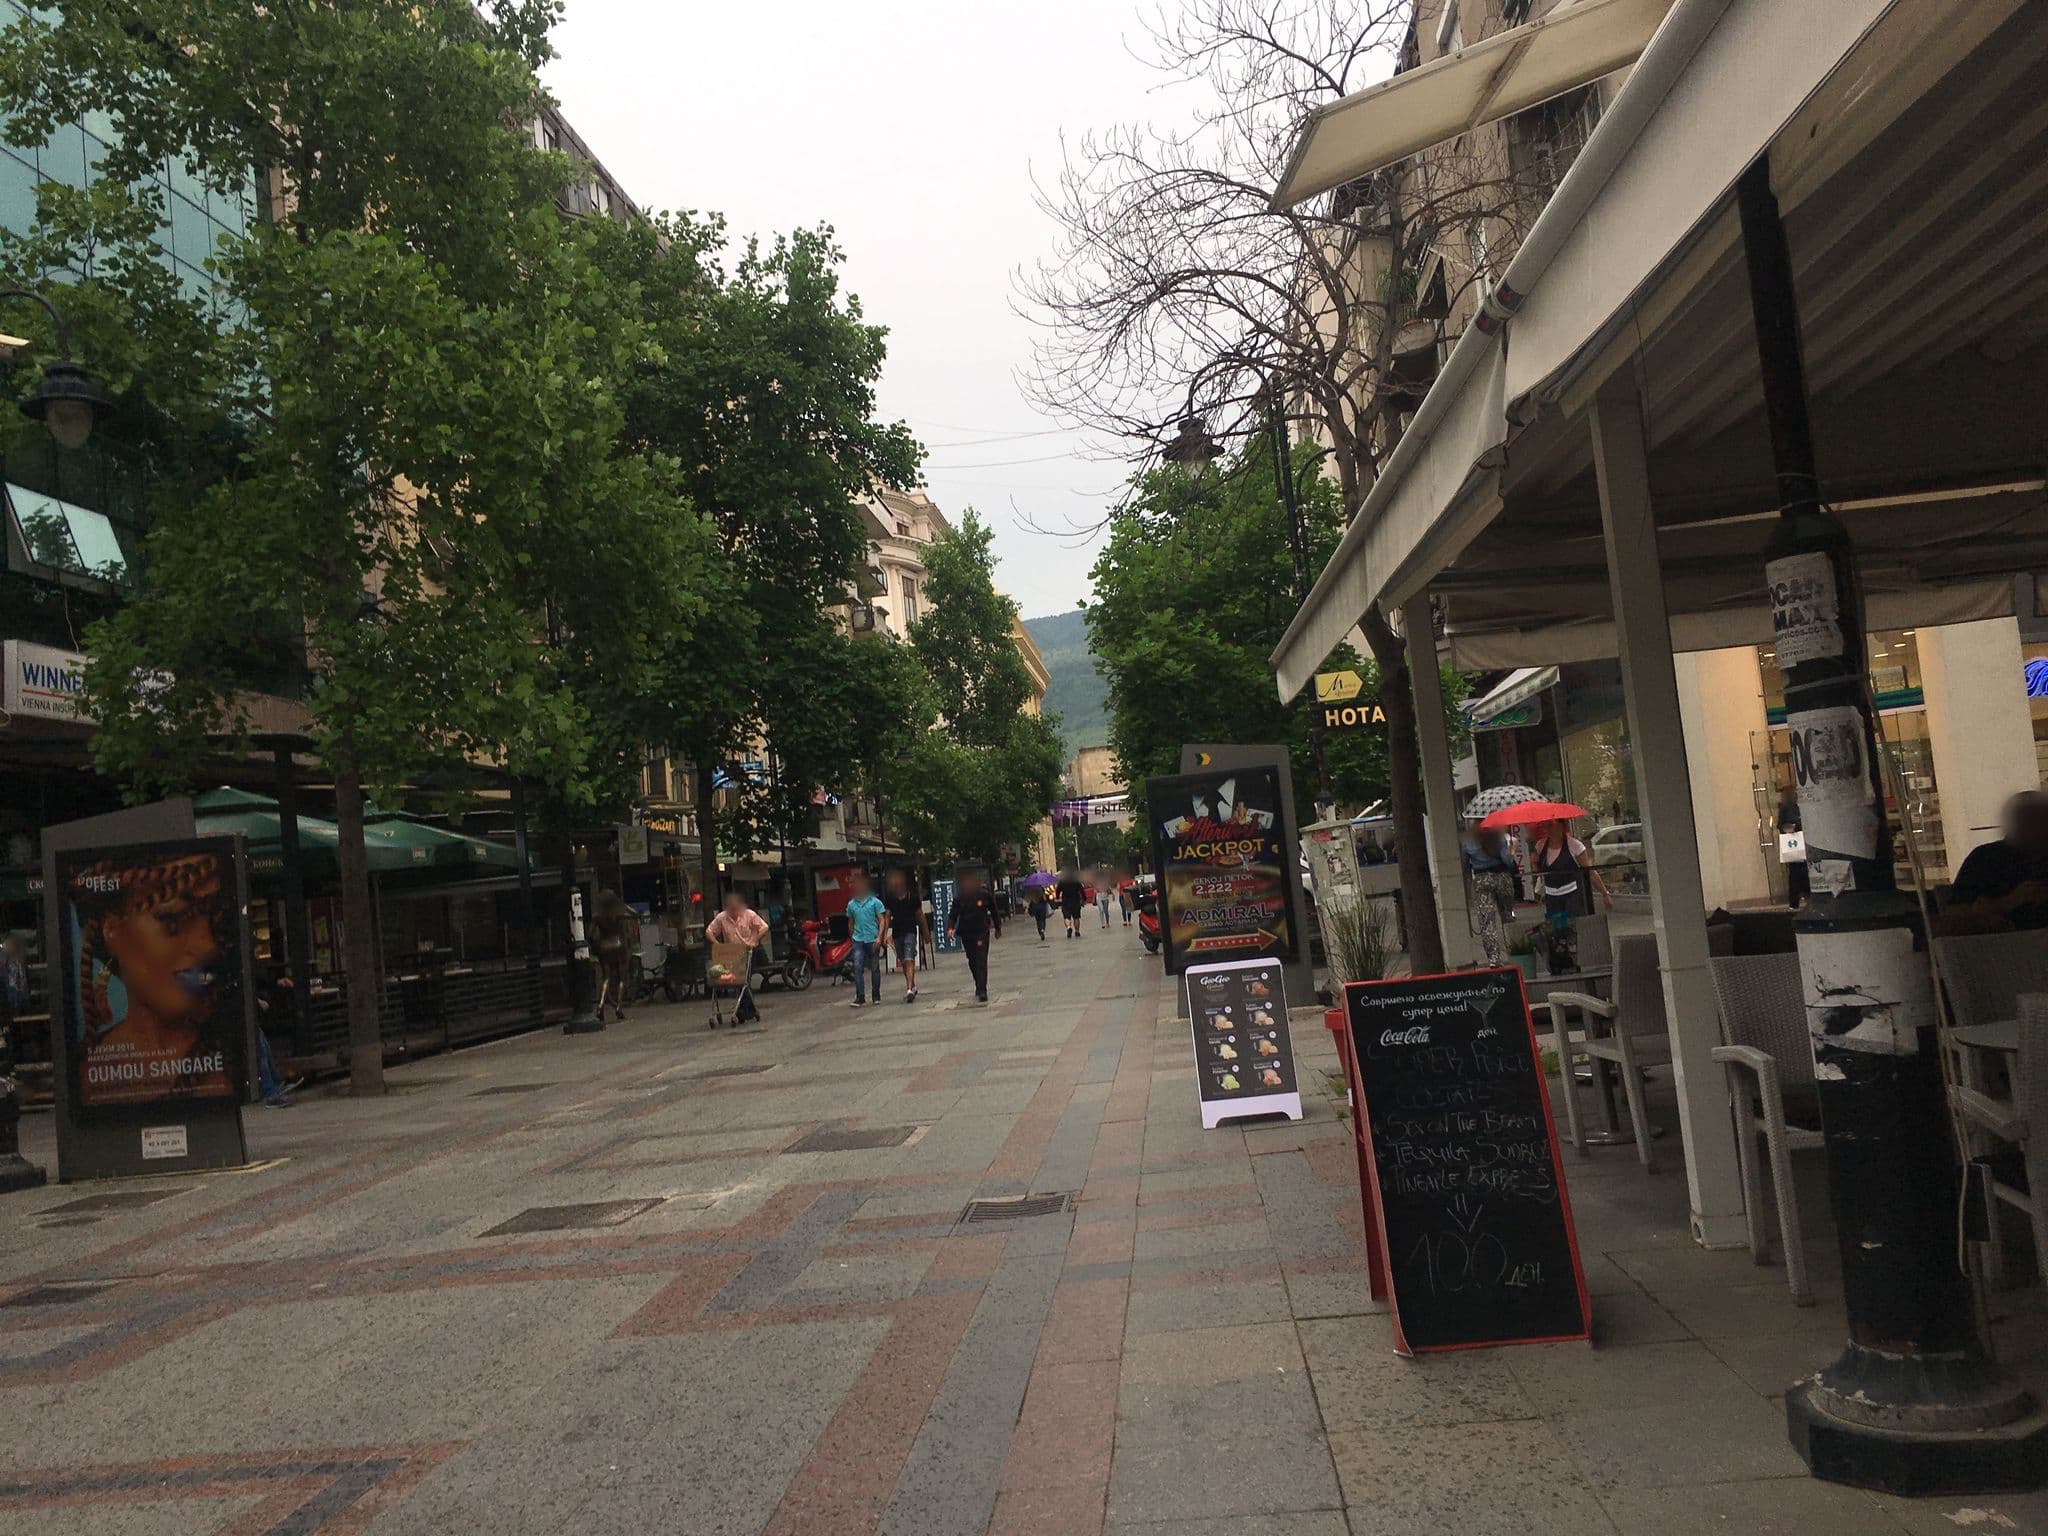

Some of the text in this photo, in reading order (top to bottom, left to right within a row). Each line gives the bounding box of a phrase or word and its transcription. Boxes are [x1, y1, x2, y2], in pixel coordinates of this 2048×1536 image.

[22, 661, 83, 692] WINNE
[21, 697, 50, 711] VIENNA
[1173, 838, 1265, 860] JACKPOT
[1195, 883, 1233, 895] 2.222
[1180, 902, 1276, 926] ADMIRAL
[1402, 1000, 1468, 1021] супер цена!
[88, 1051, 225, 1084] OUMOU SANGARÉ
